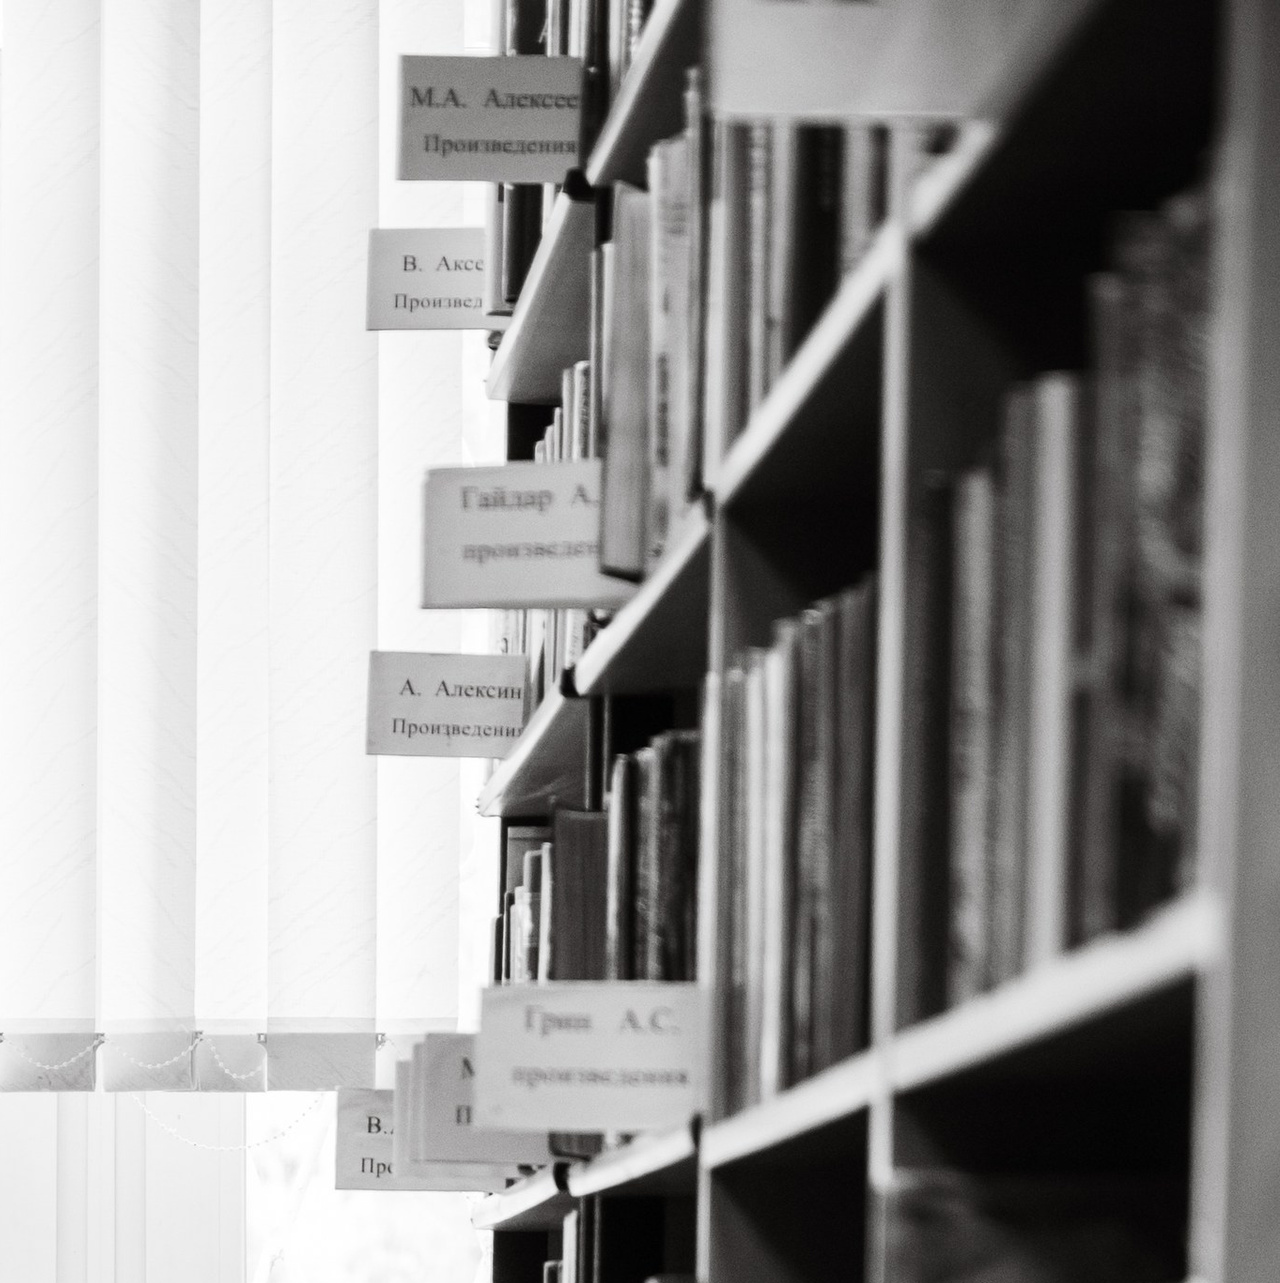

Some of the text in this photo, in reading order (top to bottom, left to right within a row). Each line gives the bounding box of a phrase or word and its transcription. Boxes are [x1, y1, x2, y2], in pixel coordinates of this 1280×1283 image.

[410, 86, 467, 108] М.А.
[403, 255, 422, 272] В.
[399, 678, 522, 700] А. Алексин
[524, 1007, 592, 1035] Грин
